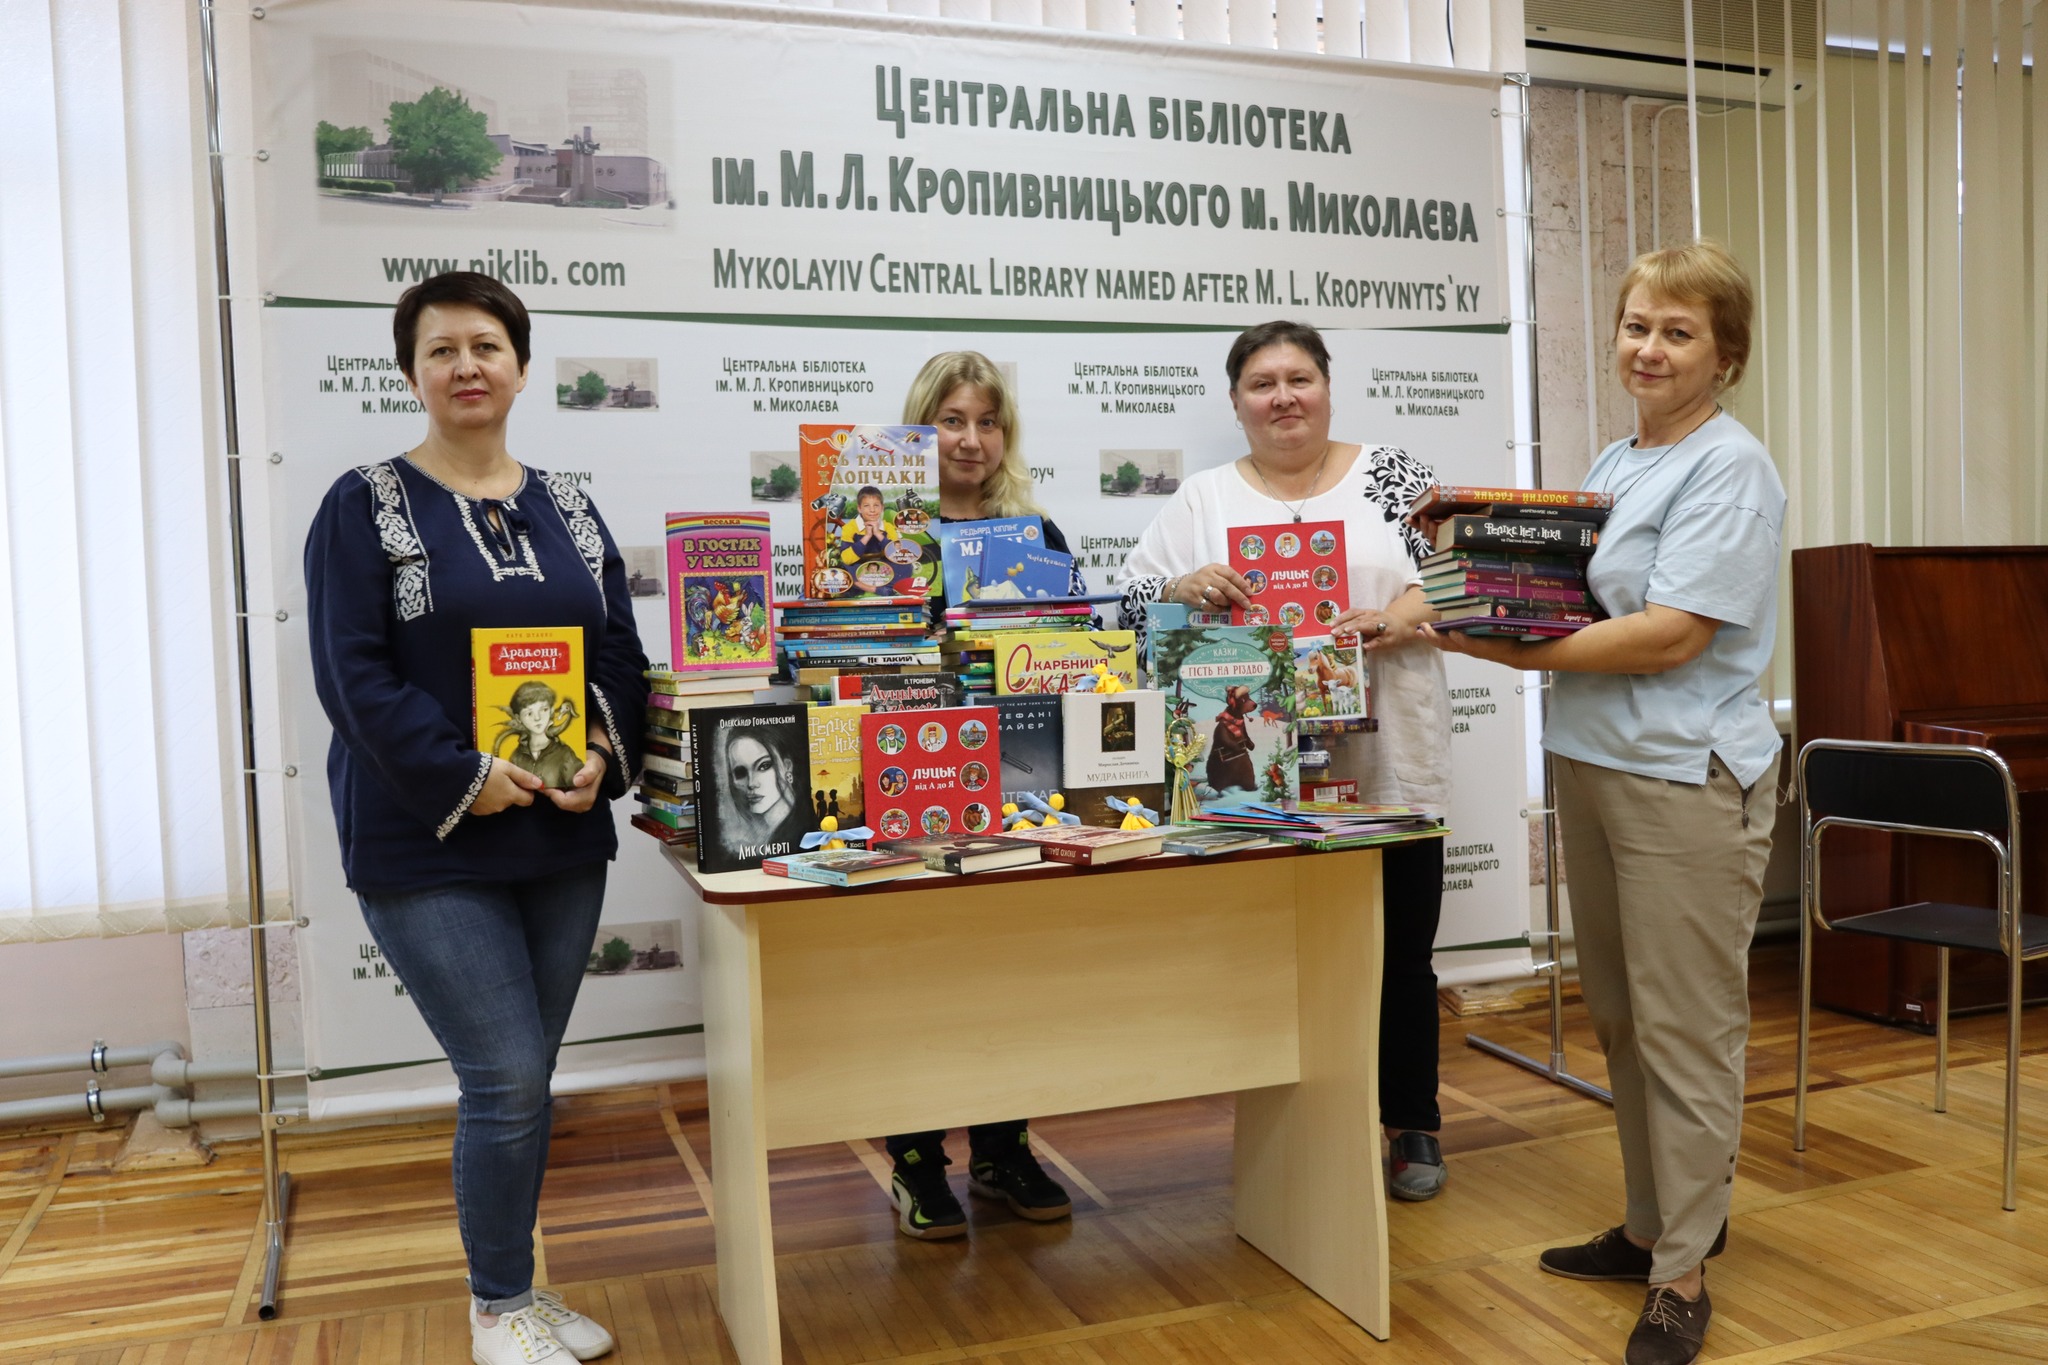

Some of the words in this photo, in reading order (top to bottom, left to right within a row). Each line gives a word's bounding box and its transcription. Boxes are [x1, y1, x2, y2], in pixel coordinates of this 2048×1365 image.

[1149, 96, 1351, 154] БІБЛІОТЕКА
[780, 150, 828, 209] М.
[836, 153, 878, 211] Л.
[567, 260, 626, 286] com
[869, 253, 982, 295] CENTRAL
[989, 257, 1088, 298] LIBRARY
[1096, 268, 1175, 301] NAMED
[1183, 272, 1249, 304] AFTER
[1255, 268, 1282, 304] M.
[1289, 270, 1309, 306] L.
[327, 355, 401, 376] ЦЕНТРАЛЬН
[803, 361, 866, 373] БІБЛІОТЕКА
[1144, 366, 1199, 377] БІБЛІОТЕКА
[1431, 371, 1479, 383] БІБЛІОТЕКА
[817, 454, 850, 467] ОСЬ
[857, 454, 896, 467] ТАКІ
[902, 454, 926, 467] МИ
[817, 470, 926, 486] ХЛОПЧАКИ
[682, 539, 696, 553] В
[698, 538, 761, 552] ГОСТЯХ
[1081, 536, 1139, 553] ЦЕНТРАЛЬН
[686, 555, 699, 569] У
[702, 554, 759, 568] КАЗКИ
[1271, 570, 1310, 581] ЛУЦЬК
[1213, 648, 1238, 657] КАЗКИ
[1188, 667, 1213, 677] ГІСТЬ
[1217, 666, 1229, 675] НА
[1234, 665, 1263, 675] РІЗДВО
[1449, 687, 1491, 700] БЛІОТЕКА
[1452, 703, 1496, 719] НИЦЬКОГО
[912, 767, 956, 779] ЛУЦЬК
[1087, 773, 1117, 782] МУДРА
[1120, 770, 1149, 780] КНИГА
[915, 783, 927, 791] від
[739, 844, 756, 860] ЛИК
[759, 842, 790, 856] СМЕРТІ
[1443, 859, 1499, 875] ИВНИЦЬКОГО
[1442, 878, 1473, 891] ОЛАЄВА
